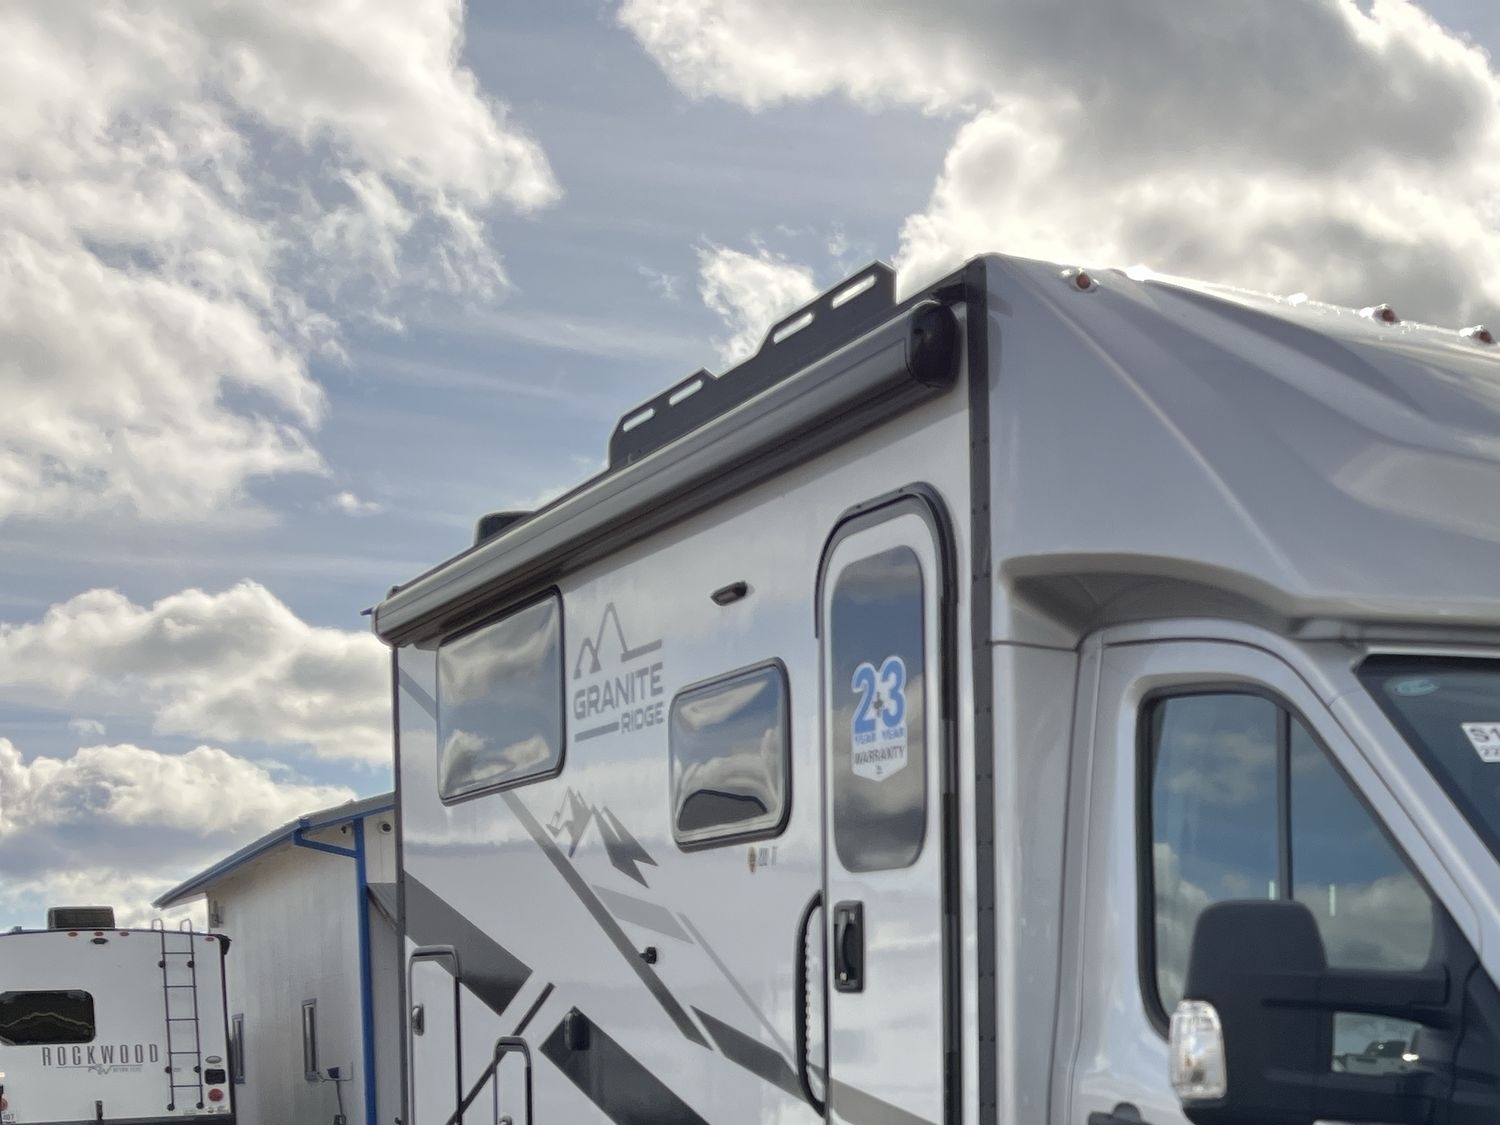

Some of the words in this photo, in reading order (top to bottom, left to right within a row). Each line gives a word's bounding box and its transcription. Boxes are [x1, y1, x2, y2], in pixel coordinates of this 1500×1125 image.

[573, 662, 663, 720] GRANITE
[620, 701, 664, 735] RIDGE
[855, 745, 905, 764] WARRANTY
[42, 1044, 158, 1066] ROCKWOOD
